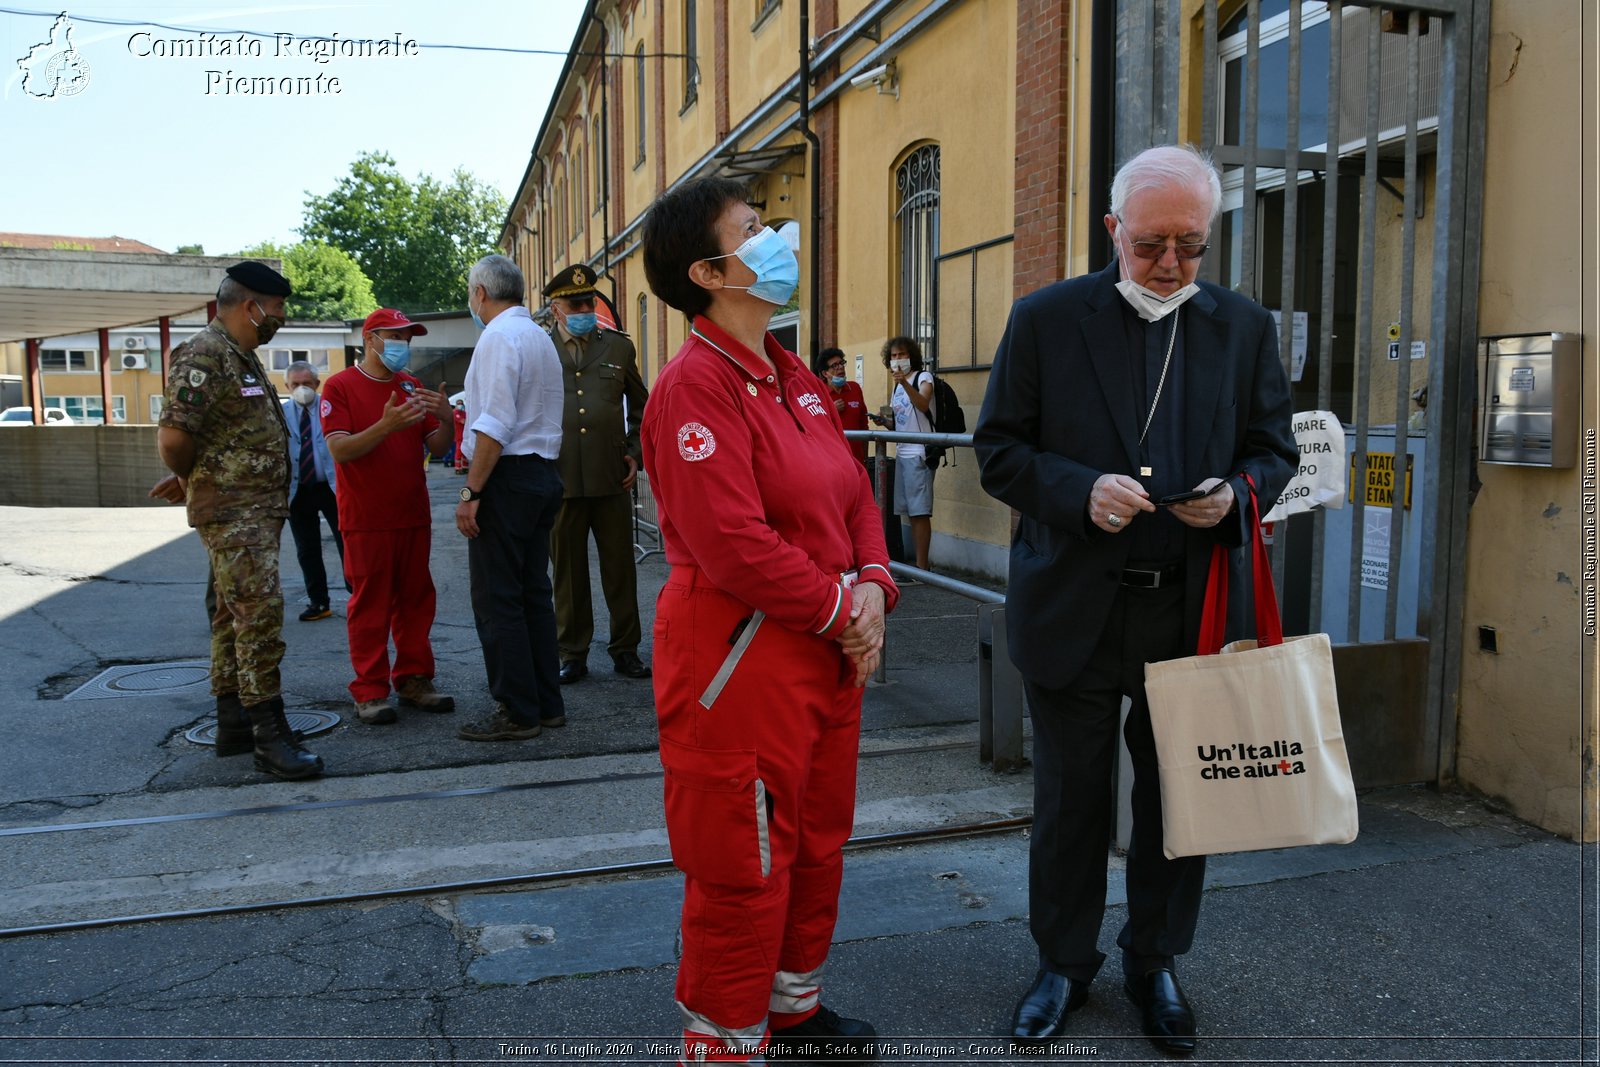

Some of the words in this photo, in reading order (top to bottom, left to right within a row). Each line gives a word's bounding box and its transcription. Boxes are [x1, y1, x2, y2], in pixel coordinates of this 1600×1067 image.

[1297, 442, 1332, 455] TURA
[1369, 471, 1391, 487] GAS
[1367, 487, 1394, 503] ETAN
[1197, 740, 1304, 761] Un'Italia
[1200, 763, 1240, 780] che
[1243, 760, 1306, 778] aiuta
